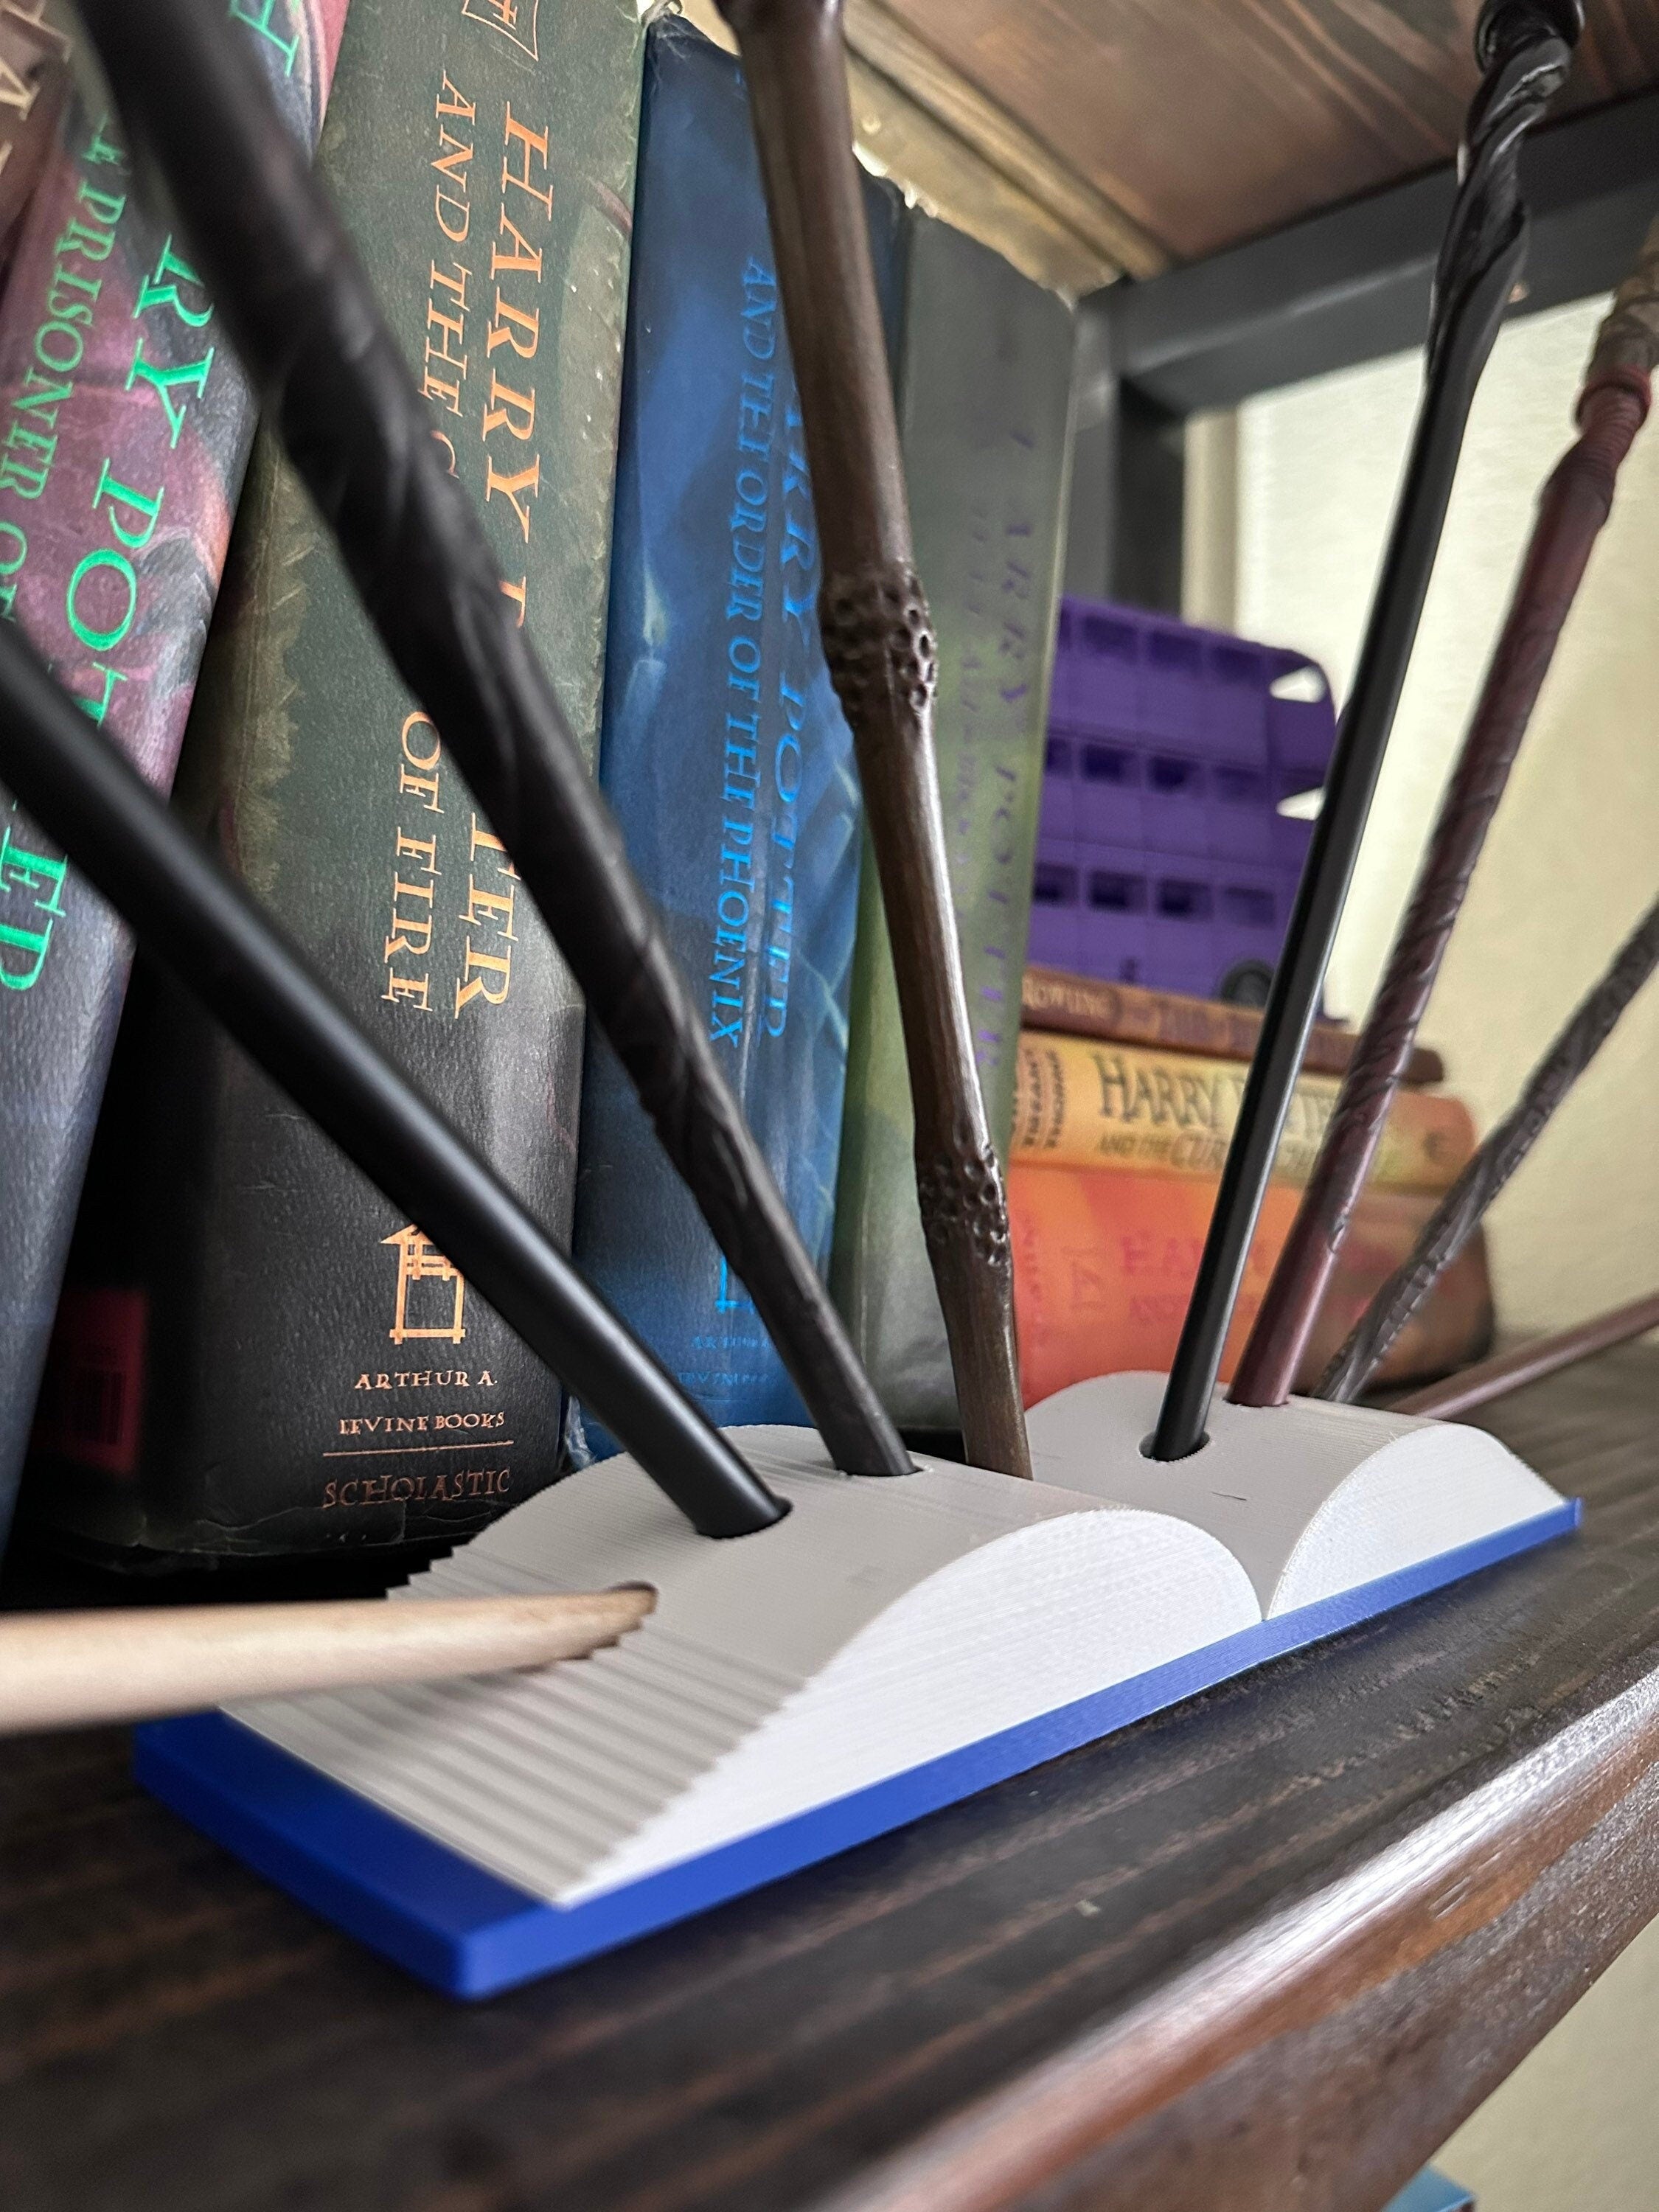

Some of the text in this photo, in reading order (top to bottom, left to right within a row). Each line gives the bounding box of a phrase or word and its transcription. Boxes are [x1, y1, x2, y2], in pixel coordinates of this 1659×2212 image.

[431, 70, 476, 243] AND
[417, 259, 473, 417] THE
[482, 101, 554, 544] HARRY
[741, 255, 777, 361] AND
[725, 468, 768, 622] ORDER
[727, 636, 761, 703] OF
[720, 713, 761, 810] THE
[380, 710, 445, 1012] OF FIRE
[709, 816, 755, 1048] PHOENIX
[1092, 1050, 1218, 1128] HARRY
[339, 1411, 505, 1435] LEVINE BOOKS
[354, 1368, 498, 1391] ARTHUR A.
[321, 1466, 511, 1509] SCHOLASTIC
